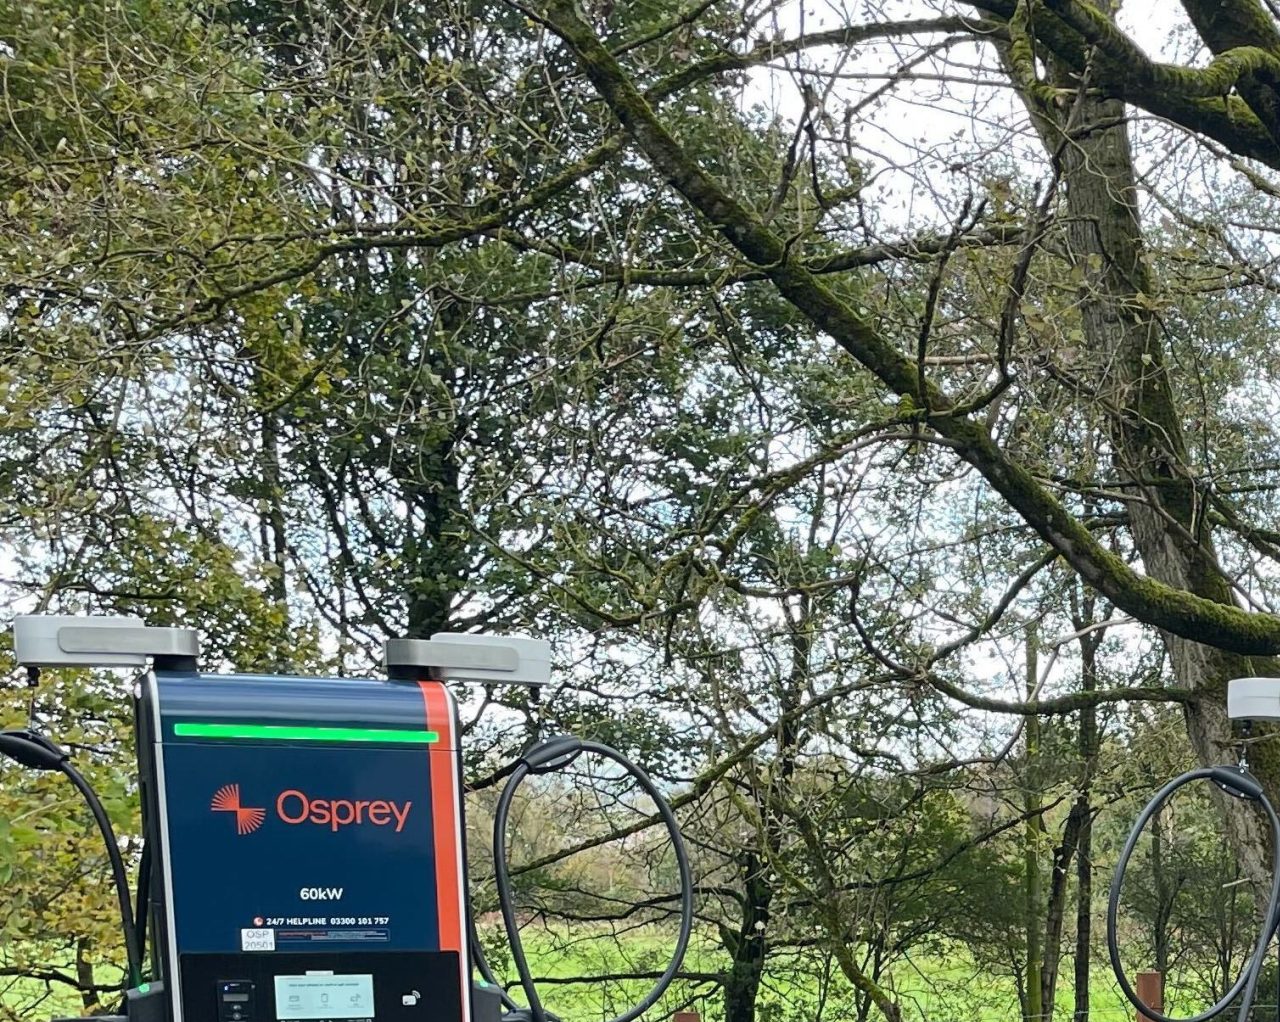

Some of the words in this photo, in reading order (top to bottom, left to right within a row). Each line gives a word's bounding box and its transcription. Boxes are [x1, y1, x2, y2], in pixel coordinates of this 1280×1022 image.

[276, 789, 412, 832] Osprey
[300, 887, 343, 900] 60kW
[266, 917, 284, 926] 24/7
[286, 917, 327, 925] HELPLINE
[330, 917, 356, 925] 03300
[357, 917, 372, 925] 101
[374, 917, 389, 925] 757
[246, 930, 270, 939] OSP
[244, 941, 273, 949] 20501
